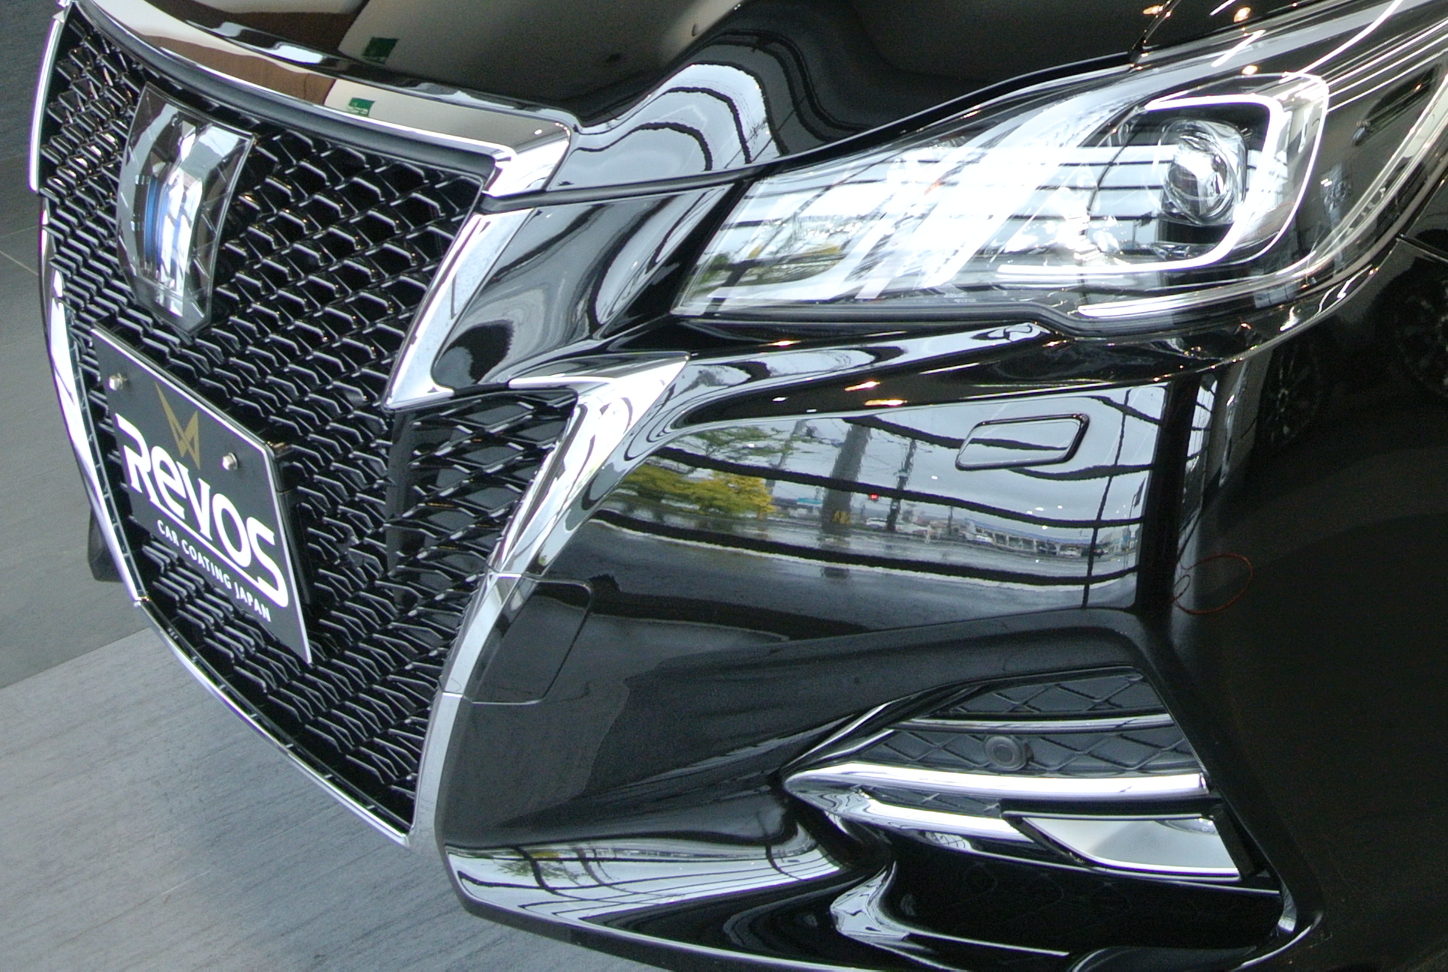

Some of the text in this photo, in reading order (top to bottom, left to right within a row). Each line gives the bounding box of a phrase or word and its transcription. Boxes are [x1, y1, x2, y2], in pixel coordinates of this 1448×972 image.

[156, 519, 272, 623] CAR COATING JAPAN
